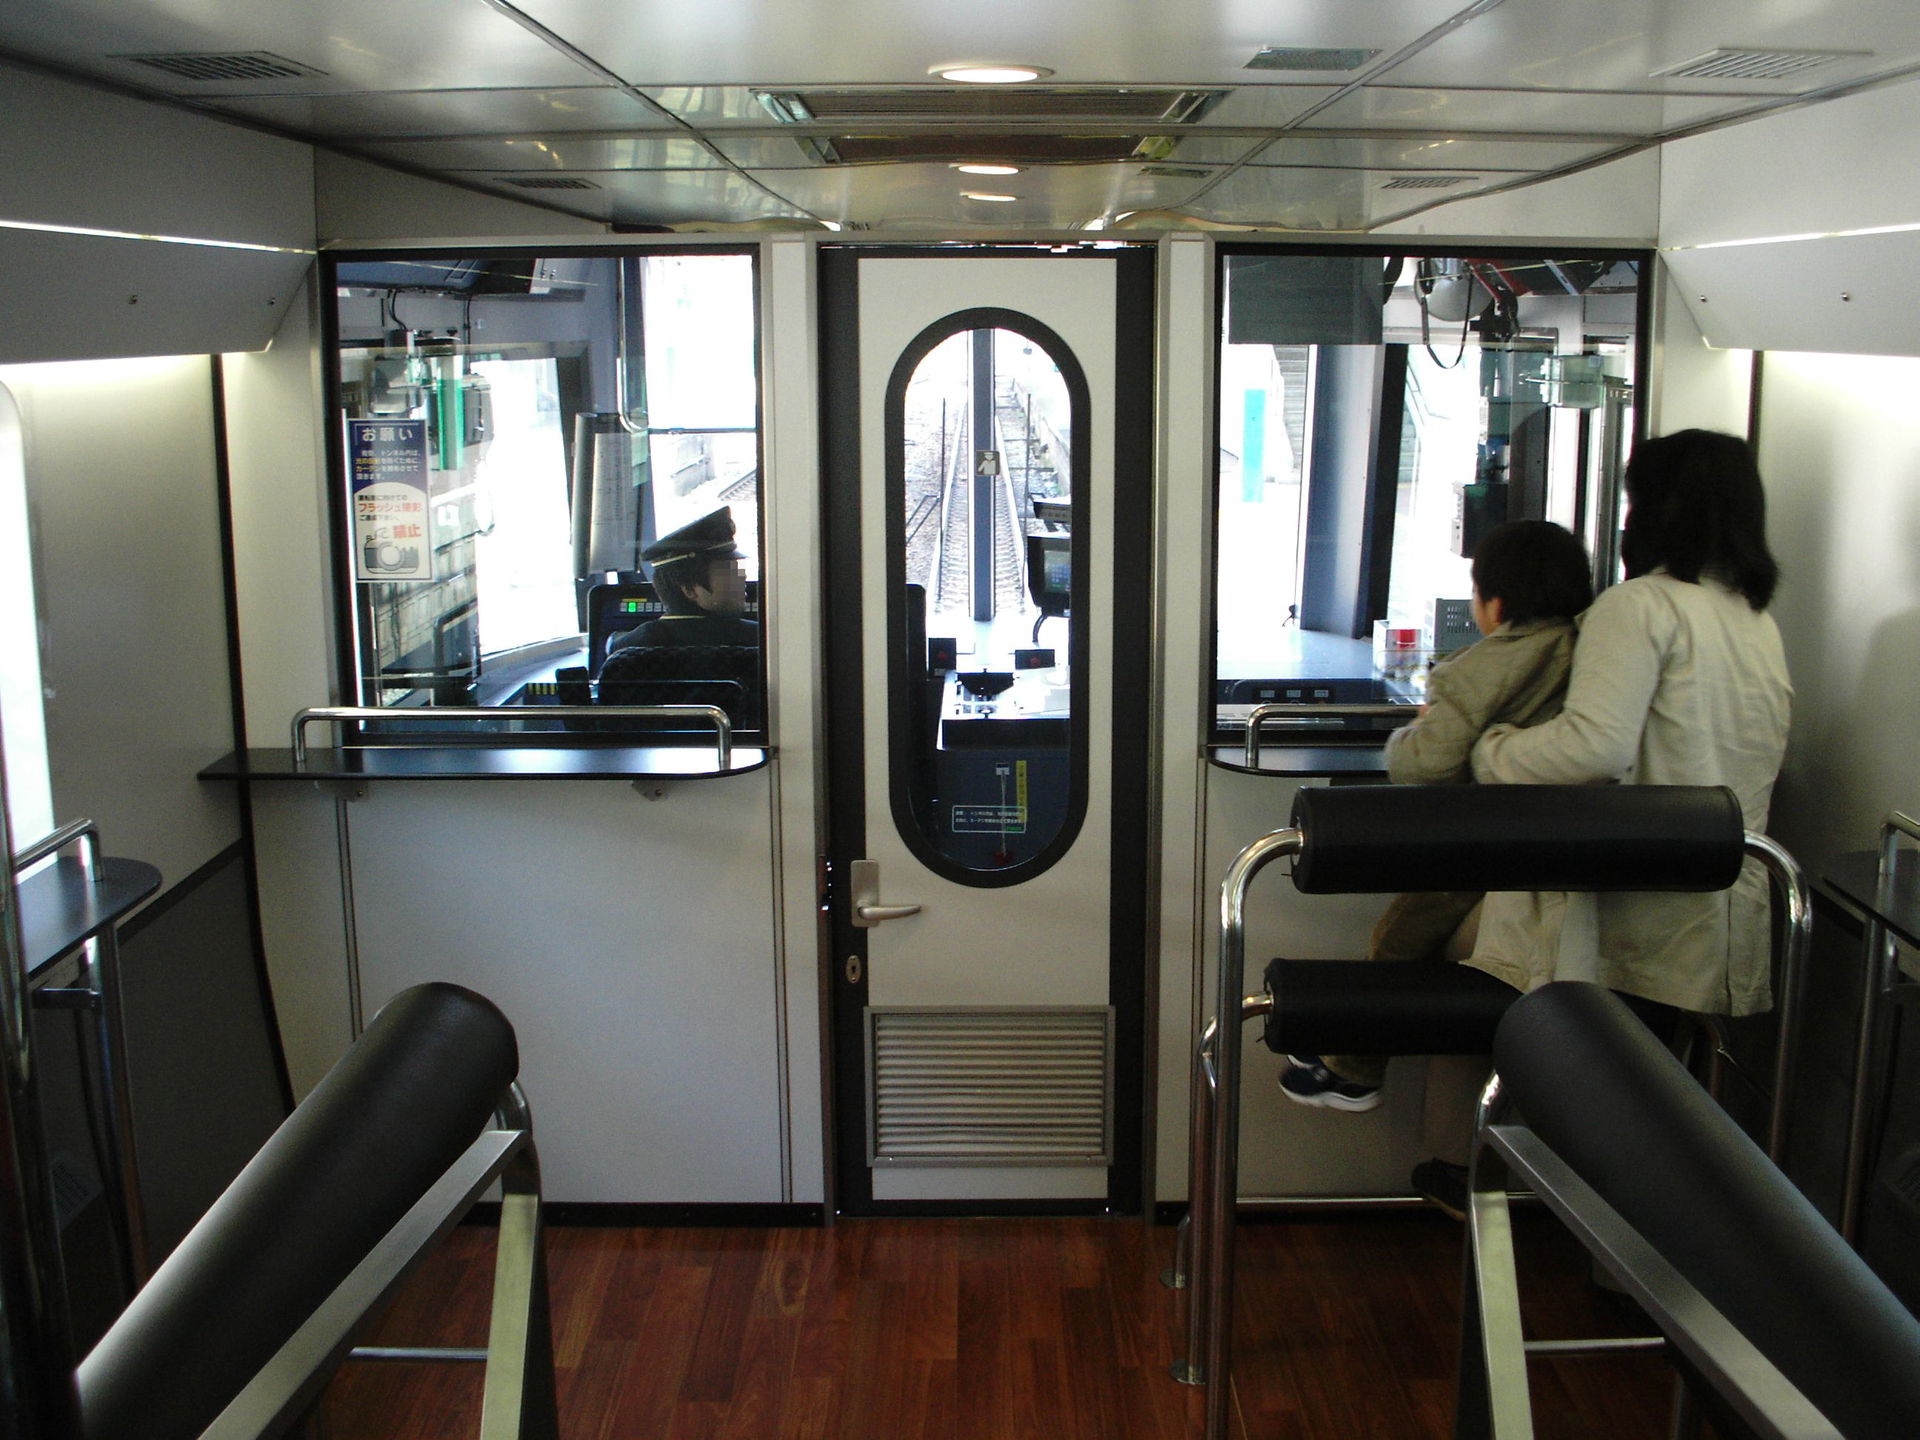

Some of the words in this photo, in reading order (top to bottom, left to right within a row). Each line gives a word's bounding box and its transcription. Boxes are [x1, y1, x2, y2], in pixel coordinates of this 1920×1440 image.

[362, 427, 413, 442] お願い
[359, 503, 422, 513] フラッシュ撮影
[393, 524, 422, 539] 禁止
